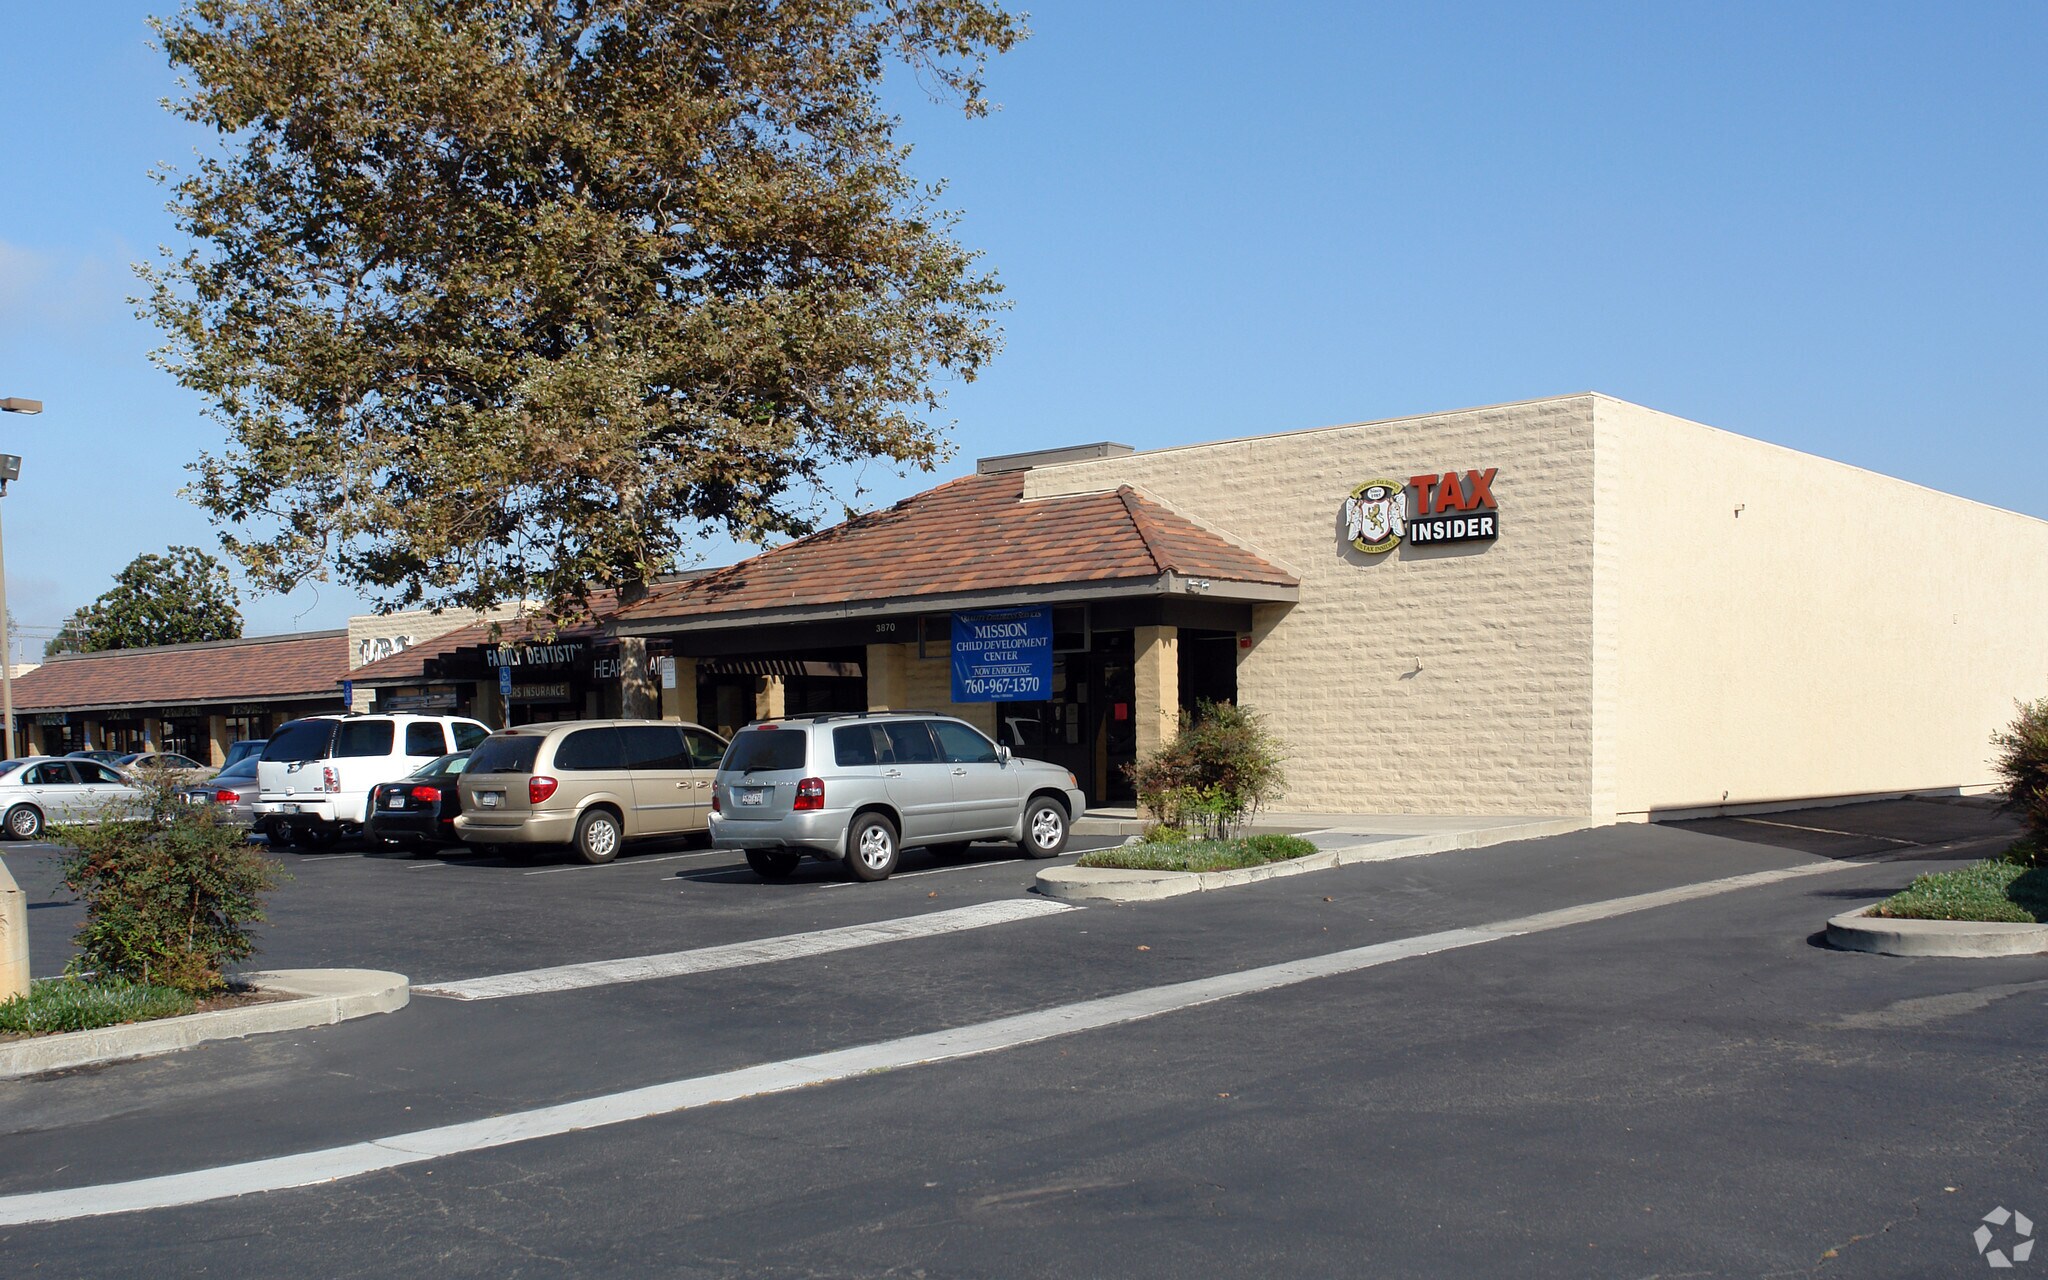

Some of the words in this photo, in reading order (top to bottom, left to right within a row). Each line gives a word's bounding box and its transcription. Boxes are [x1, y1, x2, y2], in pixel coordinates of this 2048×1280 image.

[1410, 467, 1499, 515] TAX
[1411, 517, 1494, 542] INSIDER
[875, 622, 896, 633] 3870
[975, 623, 1028, 639] MISSION
[956, 640, 982, 652] CHILD
[983, 637, 1048, 650] DEVELOPMENT
[486, 646, 521, 667] FAMILY
[984, 651, 1018, 661] CENTER
[974, 667, 991, 676] NOW
[991, 665, 1030, 675] ENROLLING
[523, 685, 565, 698] INSURANCE
[965, 676, 1040, 694] 760-967-1370
